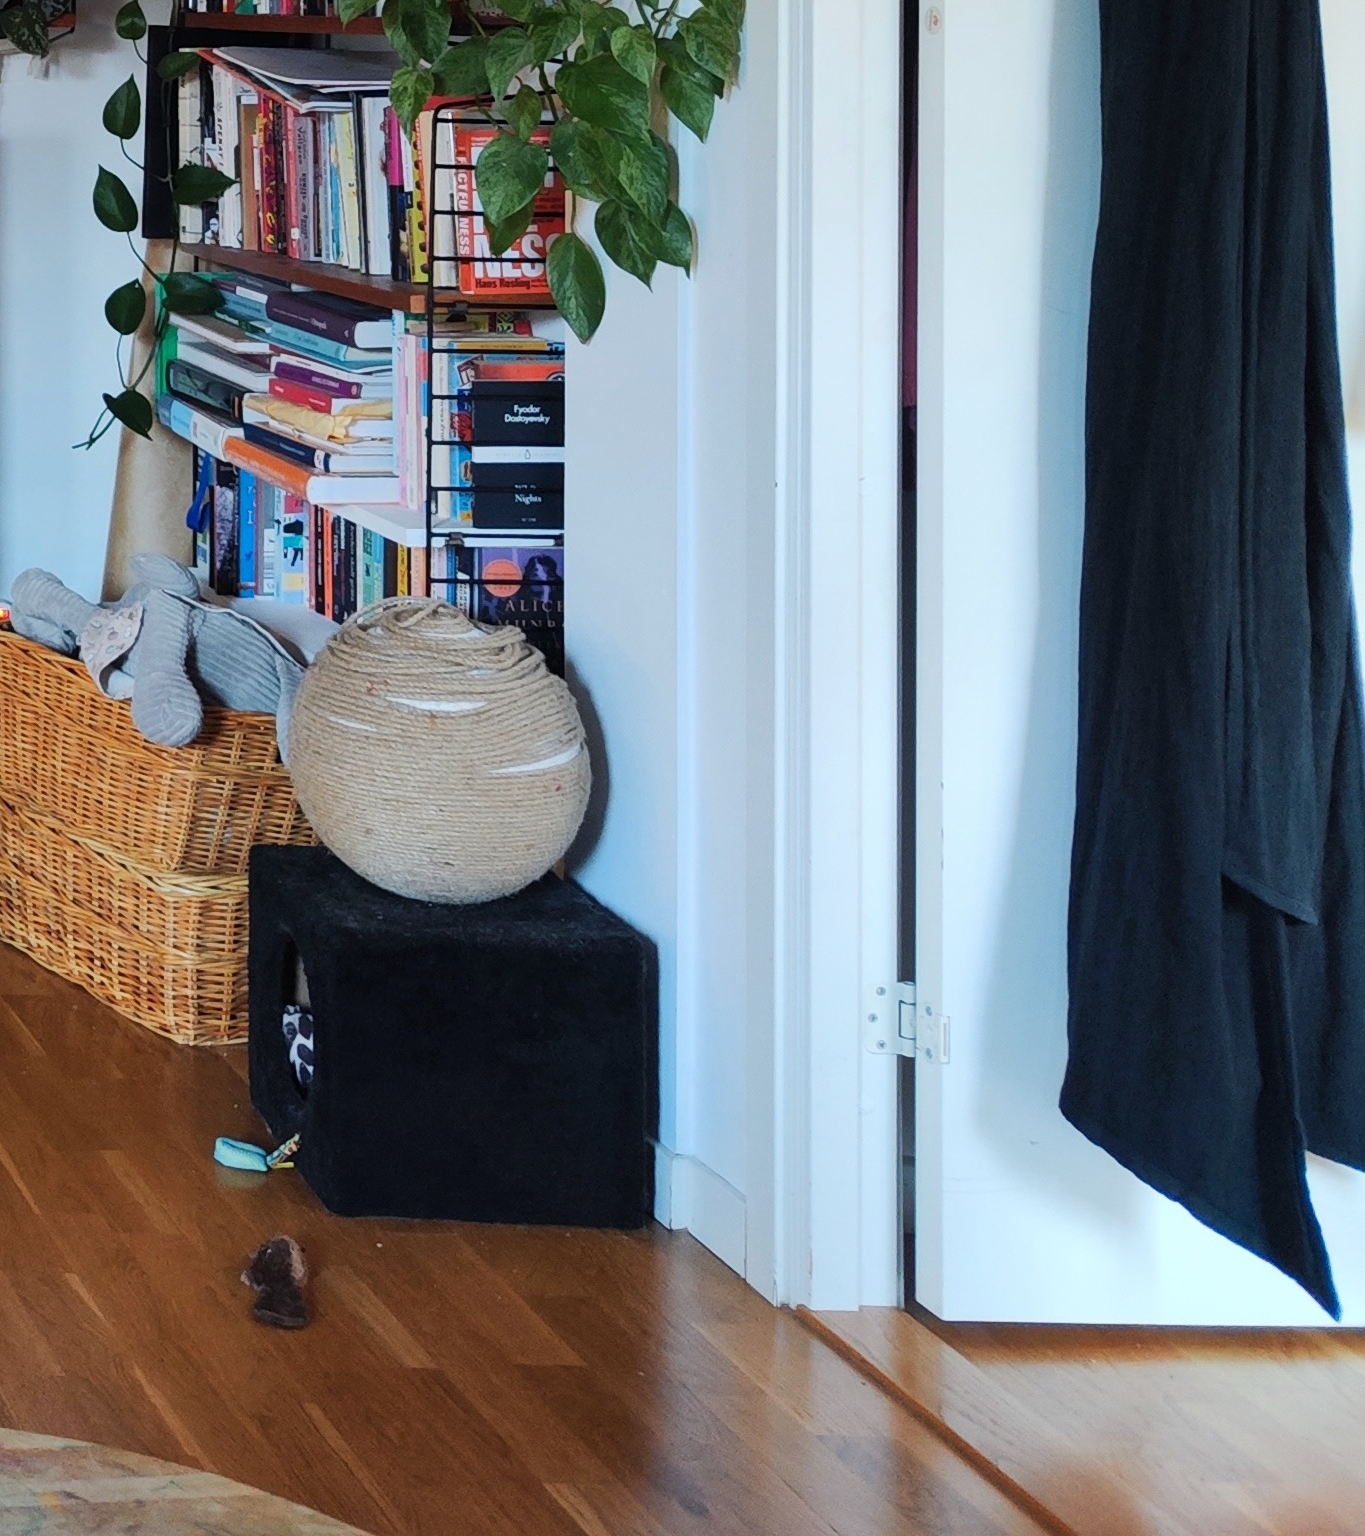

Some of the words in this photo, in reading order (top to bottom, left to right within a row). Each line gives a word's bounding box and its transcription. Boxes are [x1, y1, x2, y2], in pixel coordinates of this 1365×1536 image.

[475, 280, 497, 289] Hans
[499, 278, 531, 290] Rosling
[513, 404, 541, 415] Fyodor
[504, 414, 550, 425] Dostoyevsky
[514, 494, 542, 505] Nights
